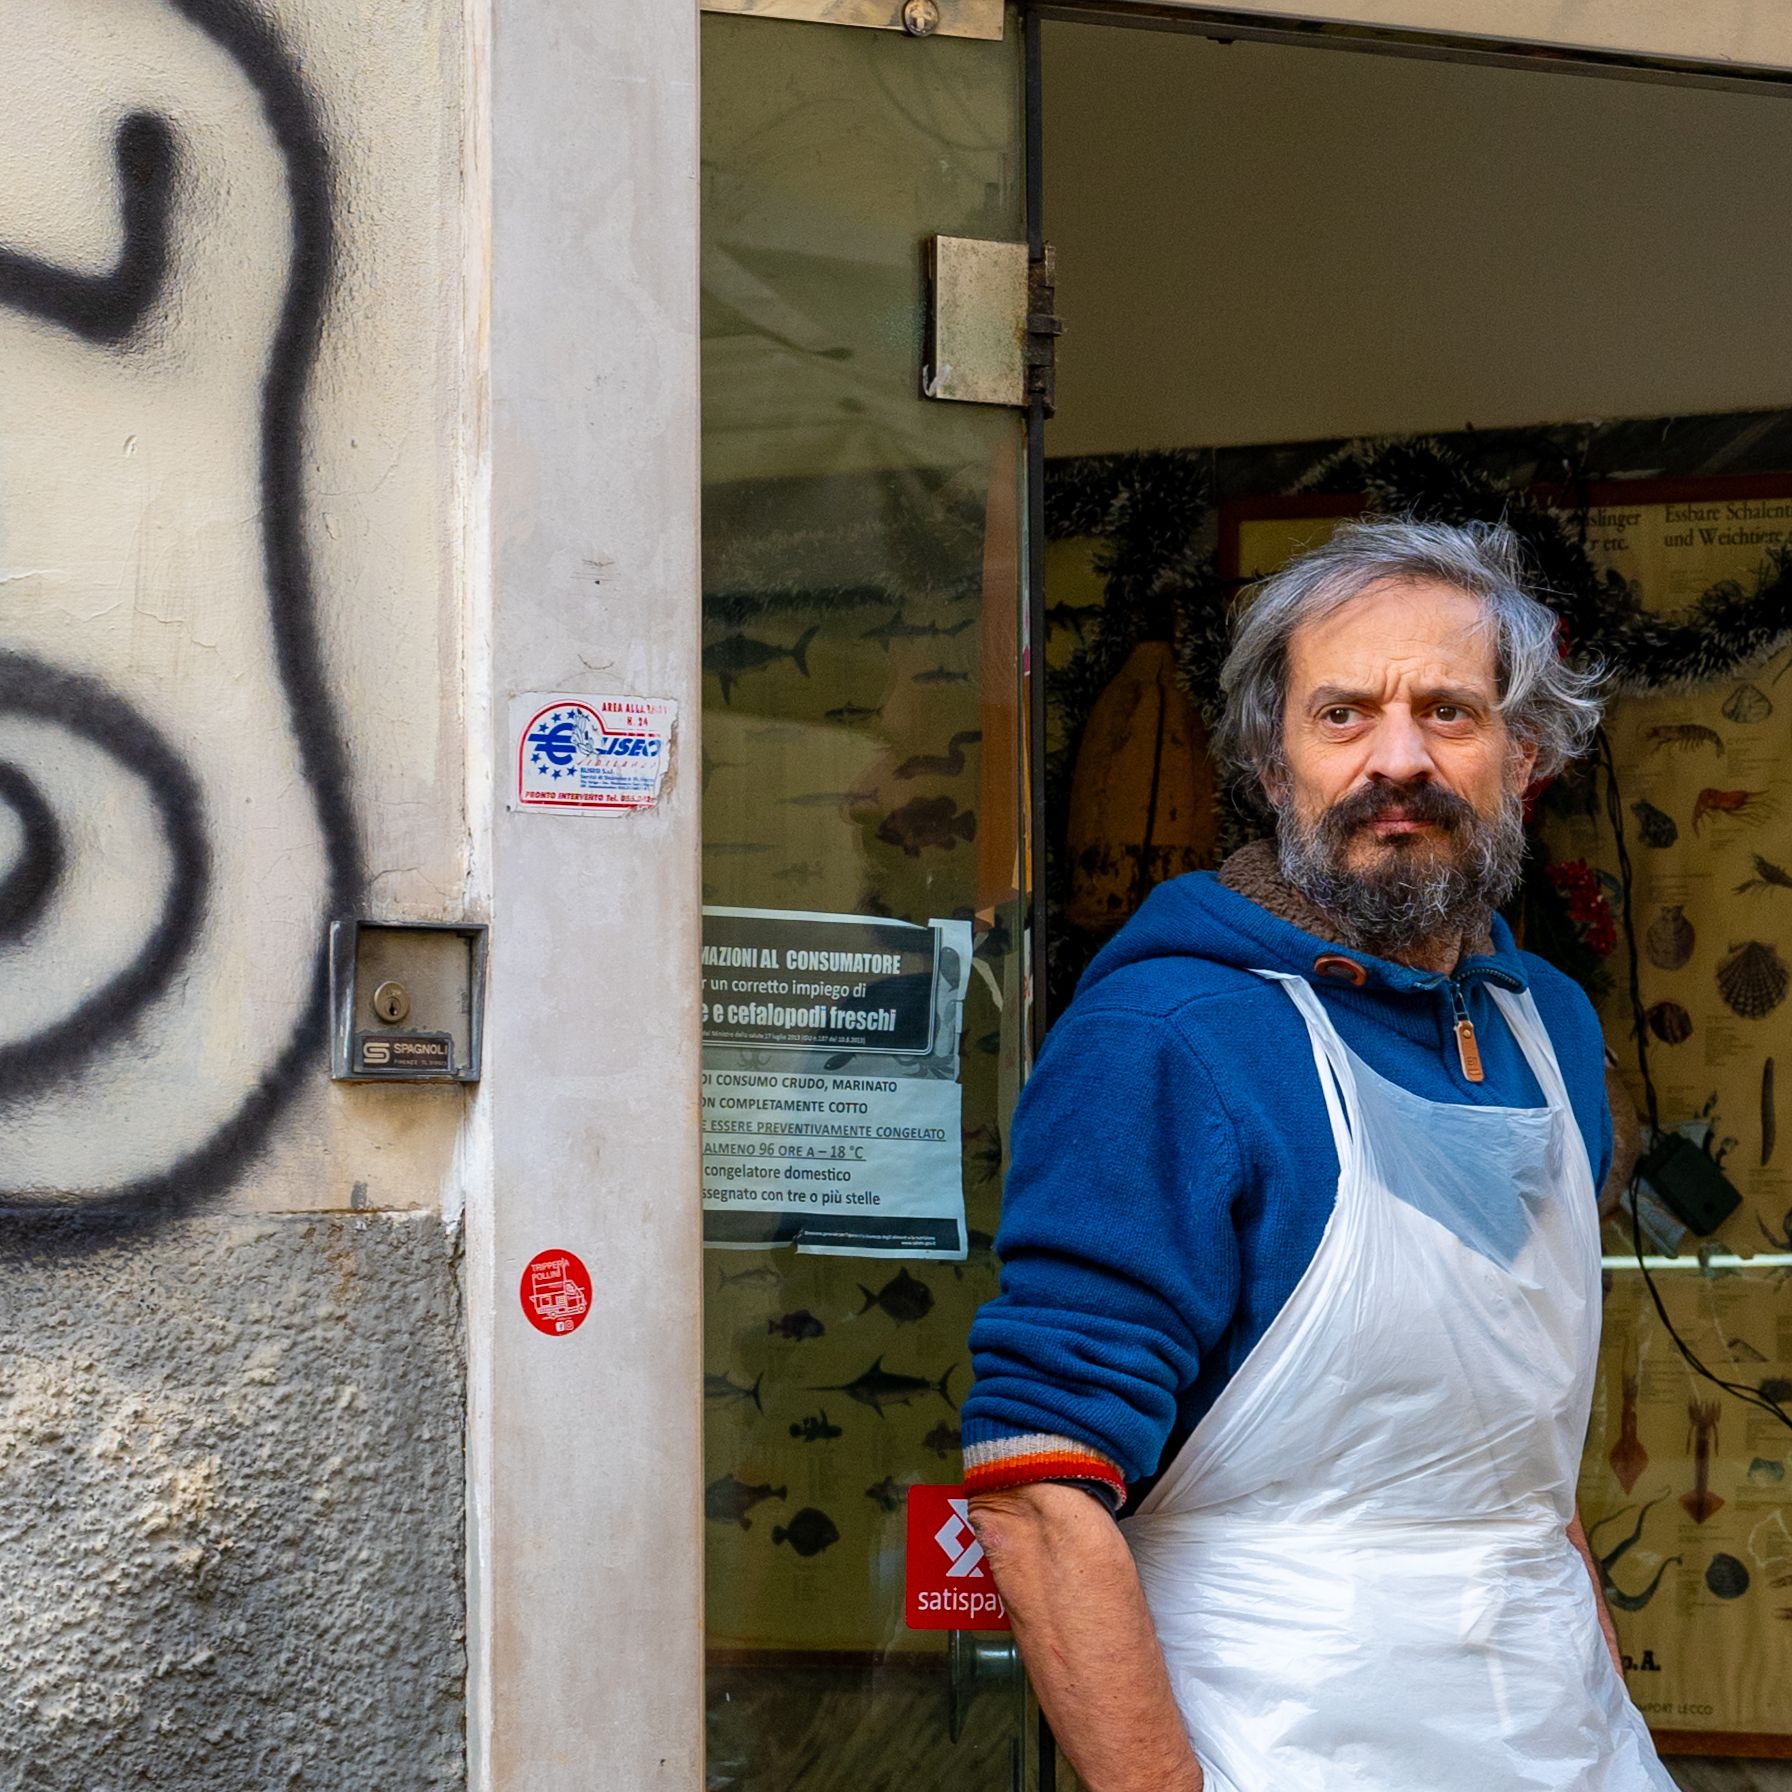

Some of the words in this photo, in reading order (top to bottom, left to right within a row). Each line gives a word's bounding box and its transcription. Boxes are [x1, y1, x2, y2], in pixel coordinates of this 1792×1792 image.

[1665, 504, 1721, 523] Essbare
[1665, 530, 1694, 547] und
[526, 791, 556, 799] PRONTO
[558, 793, 603, 801] INTERVENTO
[760, 948, 779, 968] AL
[786, 949, 901, 974] CONSUMATORE
[711, 980, 728, 991] un
[732, 979, 788, 994] corretto
[792, 980, 849, 999] impiego
[853, 982, 866, 998] di
[713, 1004, 724, 1024] e
[728, 1003, 827, 1029] cefalopodi
[830, 1006, 896, 1031] freschi
[393, 1043, 448, 1055] SPAGNOLI
[716, 1074, 777, 1088] CONSUMO
[782, 1077, 829, 1092] CRUDO,
[832, 1078, 897, 1093] MARINATO
[719, 1098, 825, 1113] COMPLETAMENTE
[828, 1101, 868, 1114] COTTO
[711, 1120, 752, 1132] ESSERE
[757, 1122, 872, 1138] PREVENTIVAMENTE
[876, 1126, 945, 1140] CONGELATO
[704, 1143, 757, 1155] ALMENO
[759, 1142, 775, 1156] 96
[778, 1145, 802, 1157] ORE
[806, 1145, 815, 1158] A
[830, 1145, 846, 1158] 18
[850, 1145, 864, 1159] °C
[704, 1165, 781, 1180] congelatore
[784, 1167, 851, 1181] domestico
[761, 1189, 783, 1201] con
[788, 1189, 806, 1202] tre
[810, 1193, 818, 1203] o
[822, 1191, 842, 1206] più
[846, 1192, 881, 1205] stelle
